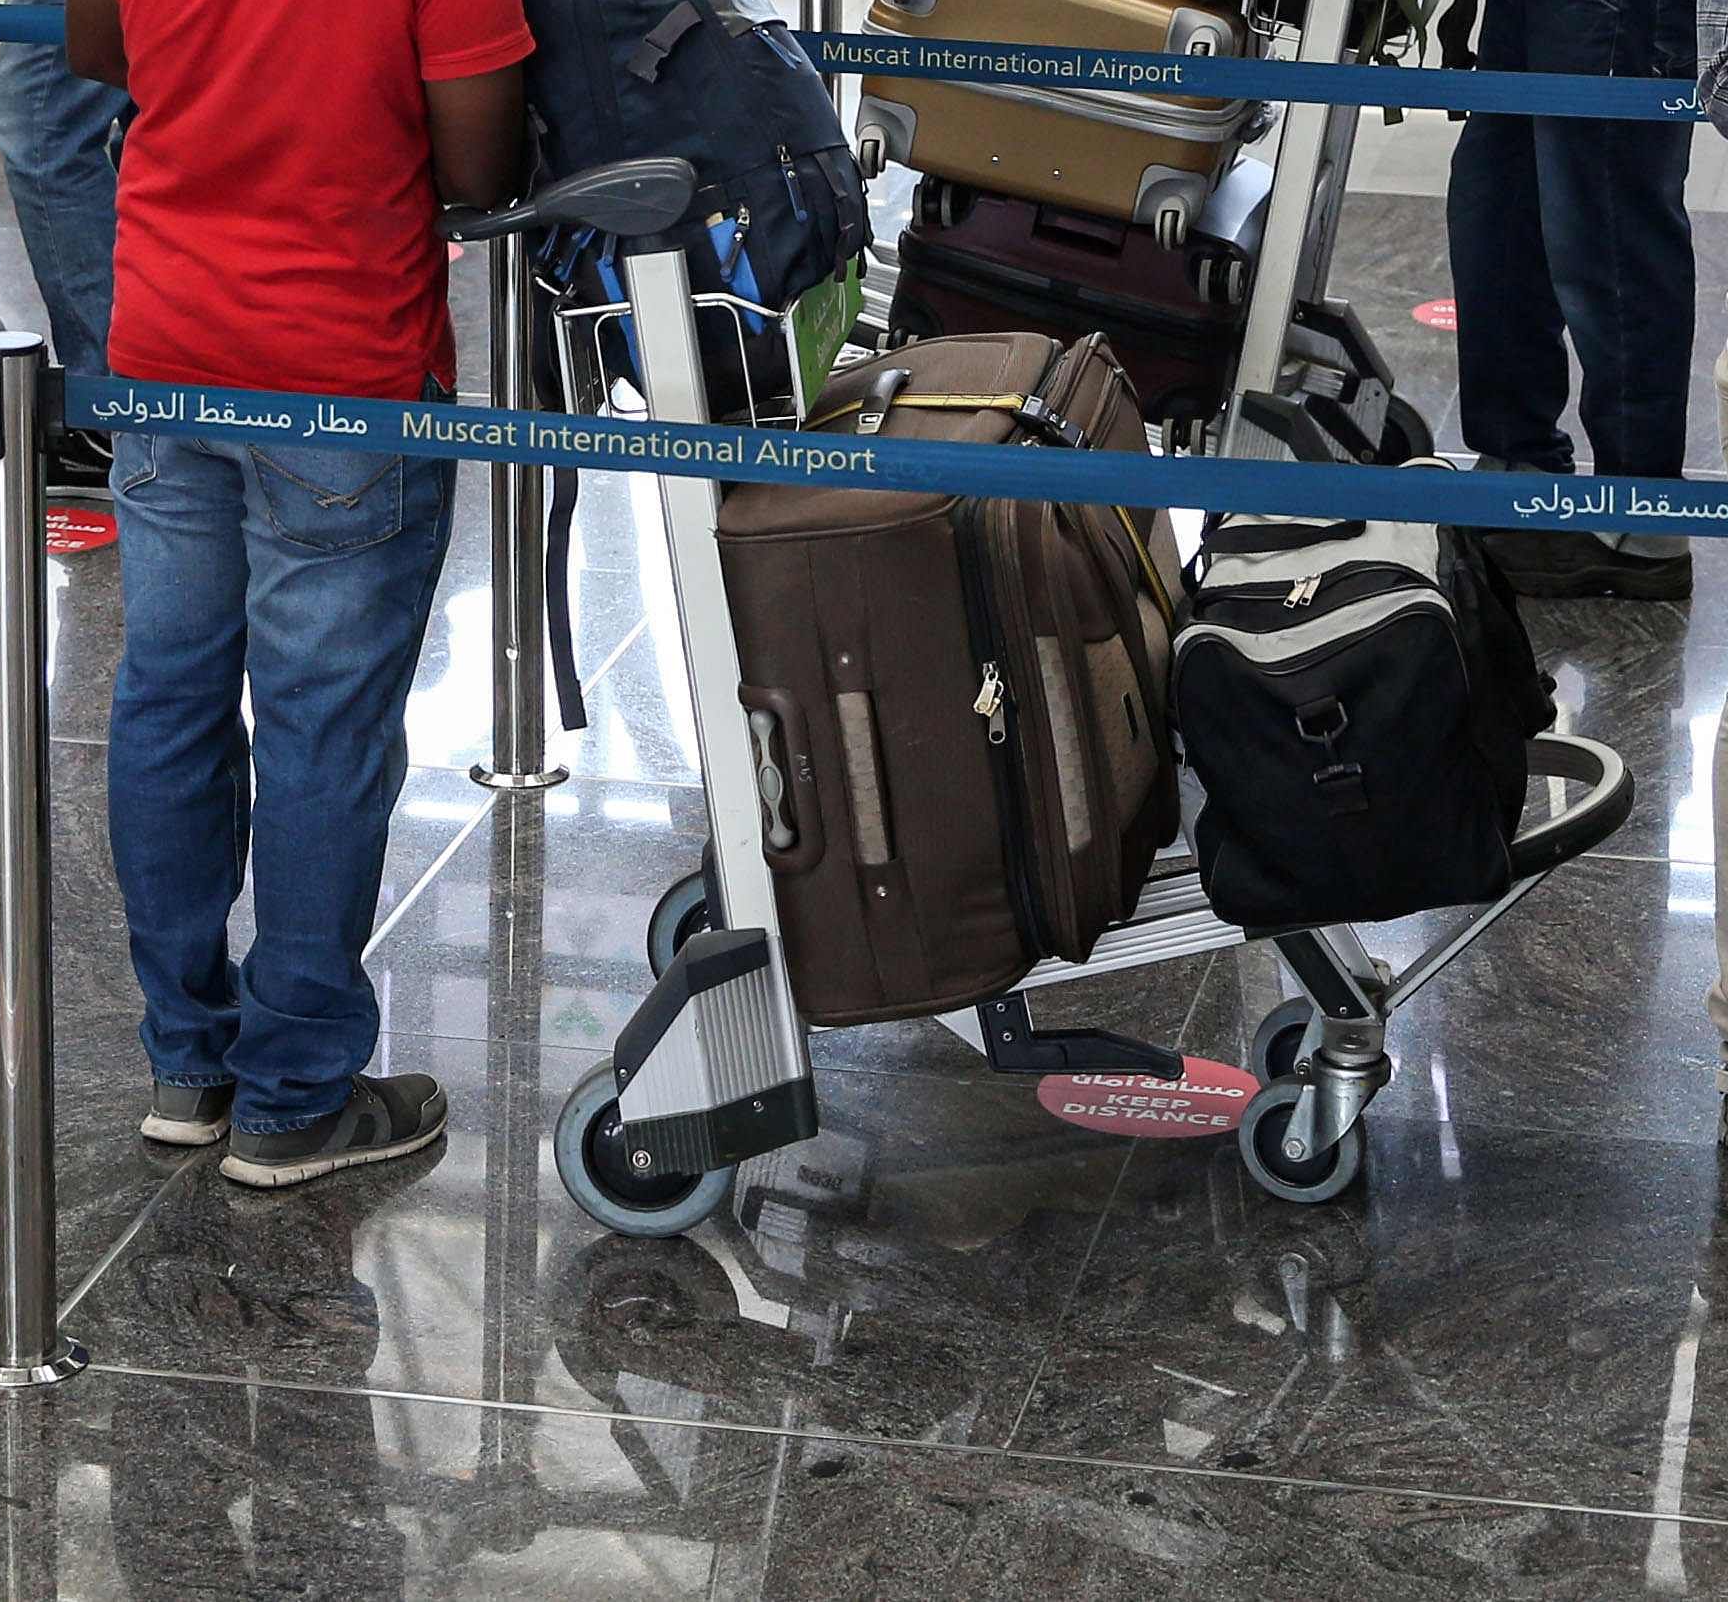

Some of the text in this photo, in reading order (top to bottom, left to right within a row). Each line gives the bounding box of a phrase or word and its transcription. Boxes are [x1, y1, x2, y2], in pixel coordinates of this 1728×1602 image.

[822, 42, 1183, 86] Muscat International Airport
[93, 389, 367, 436] مطار مسقط الدولي
[403, 413, 876, 474] Muscat International Airport
[1514, 484, 1613, 519] الدولي
[1063, 1104, 1229, 1126] DISTANCE
[1106, 1095, 1191, 1109] KEEP
